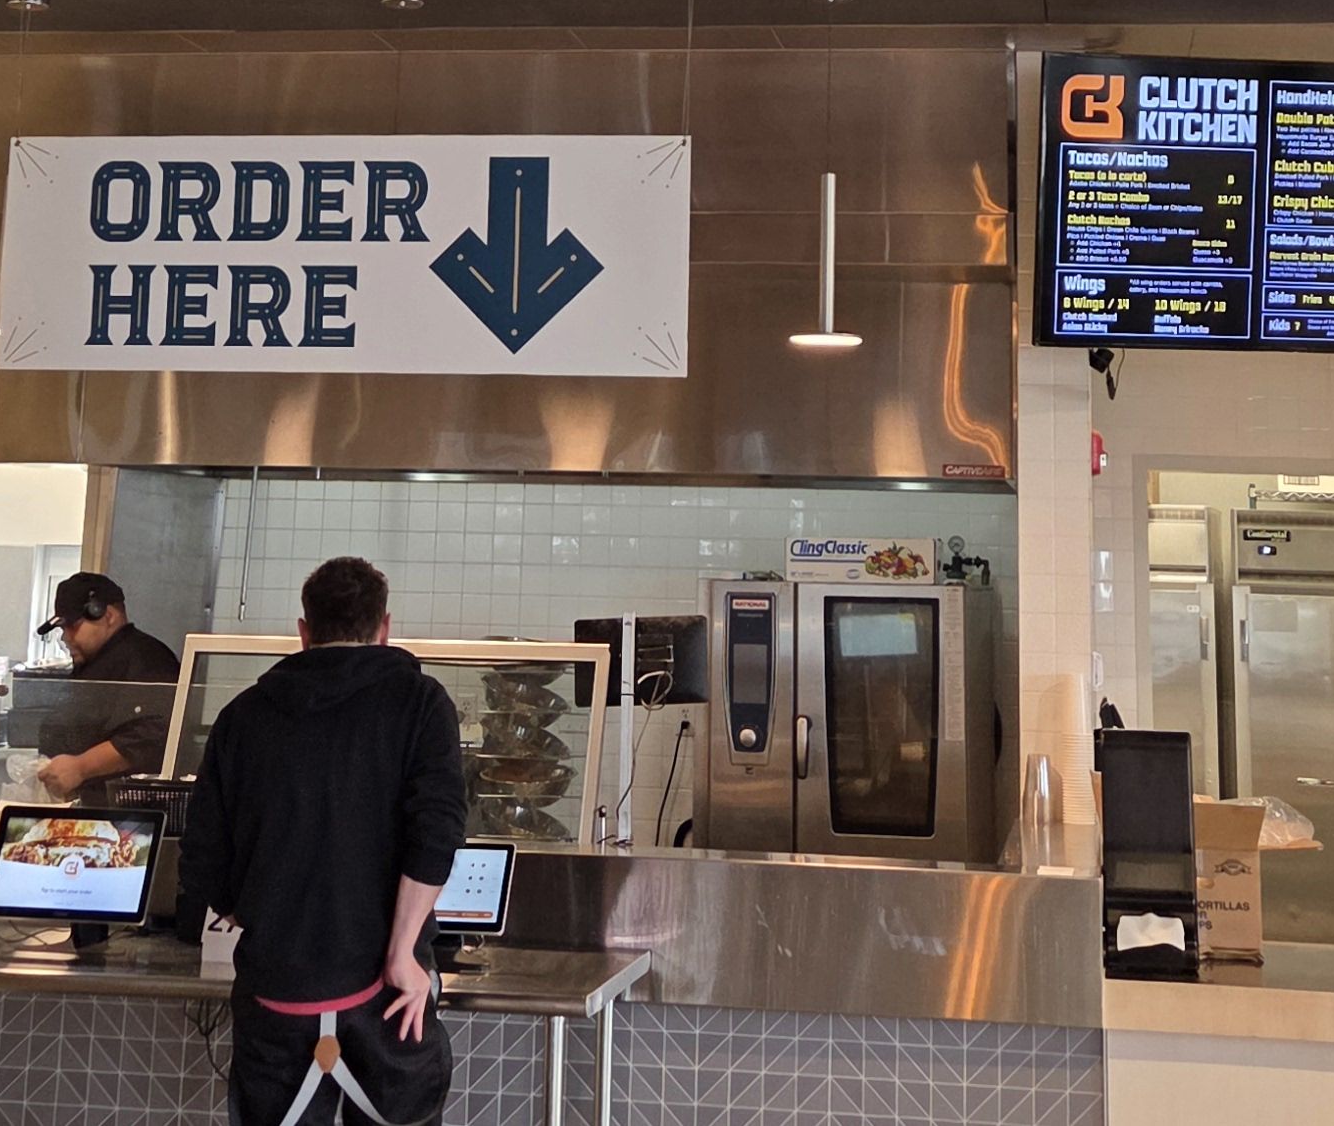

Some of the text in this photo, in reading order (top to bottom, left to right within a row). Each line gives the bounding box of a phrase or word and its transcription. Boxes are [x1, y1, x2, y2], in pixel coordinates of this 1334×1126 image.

[1139, 76, 1259, 112] CLUTCH
[1276, 112, 1313, 124] Double
[1137, 110, 1257, 144] KITCHEN
[1067, 149, 1169, 168] Tacos/Nachos
[1274, 159, 1311, 173] Clutch
[89, 160, 430, 242] ORDER
[1273, 194, 1308, 211] Crispy
[1067, 214, 1097, 224] Clutch
[1064, 274, 1106, 295] Wings
[1073, 296, 1105, 312] Wings
[1117, 298, 1129, 310] 14
[1268, 290, 1296, 304] Sides
[84, 263, 359, 348] HERE
[1155, 299, 1168, 311] 10
[1170, 298, 1201, 314] Wings
[1268, 318, 1290, 331] Kids
[790, 539, 868, 557] ClingClassic
[1198, 900, 1250, 911] ORTILLAS
[1199, 920, 1213, 930] PS
